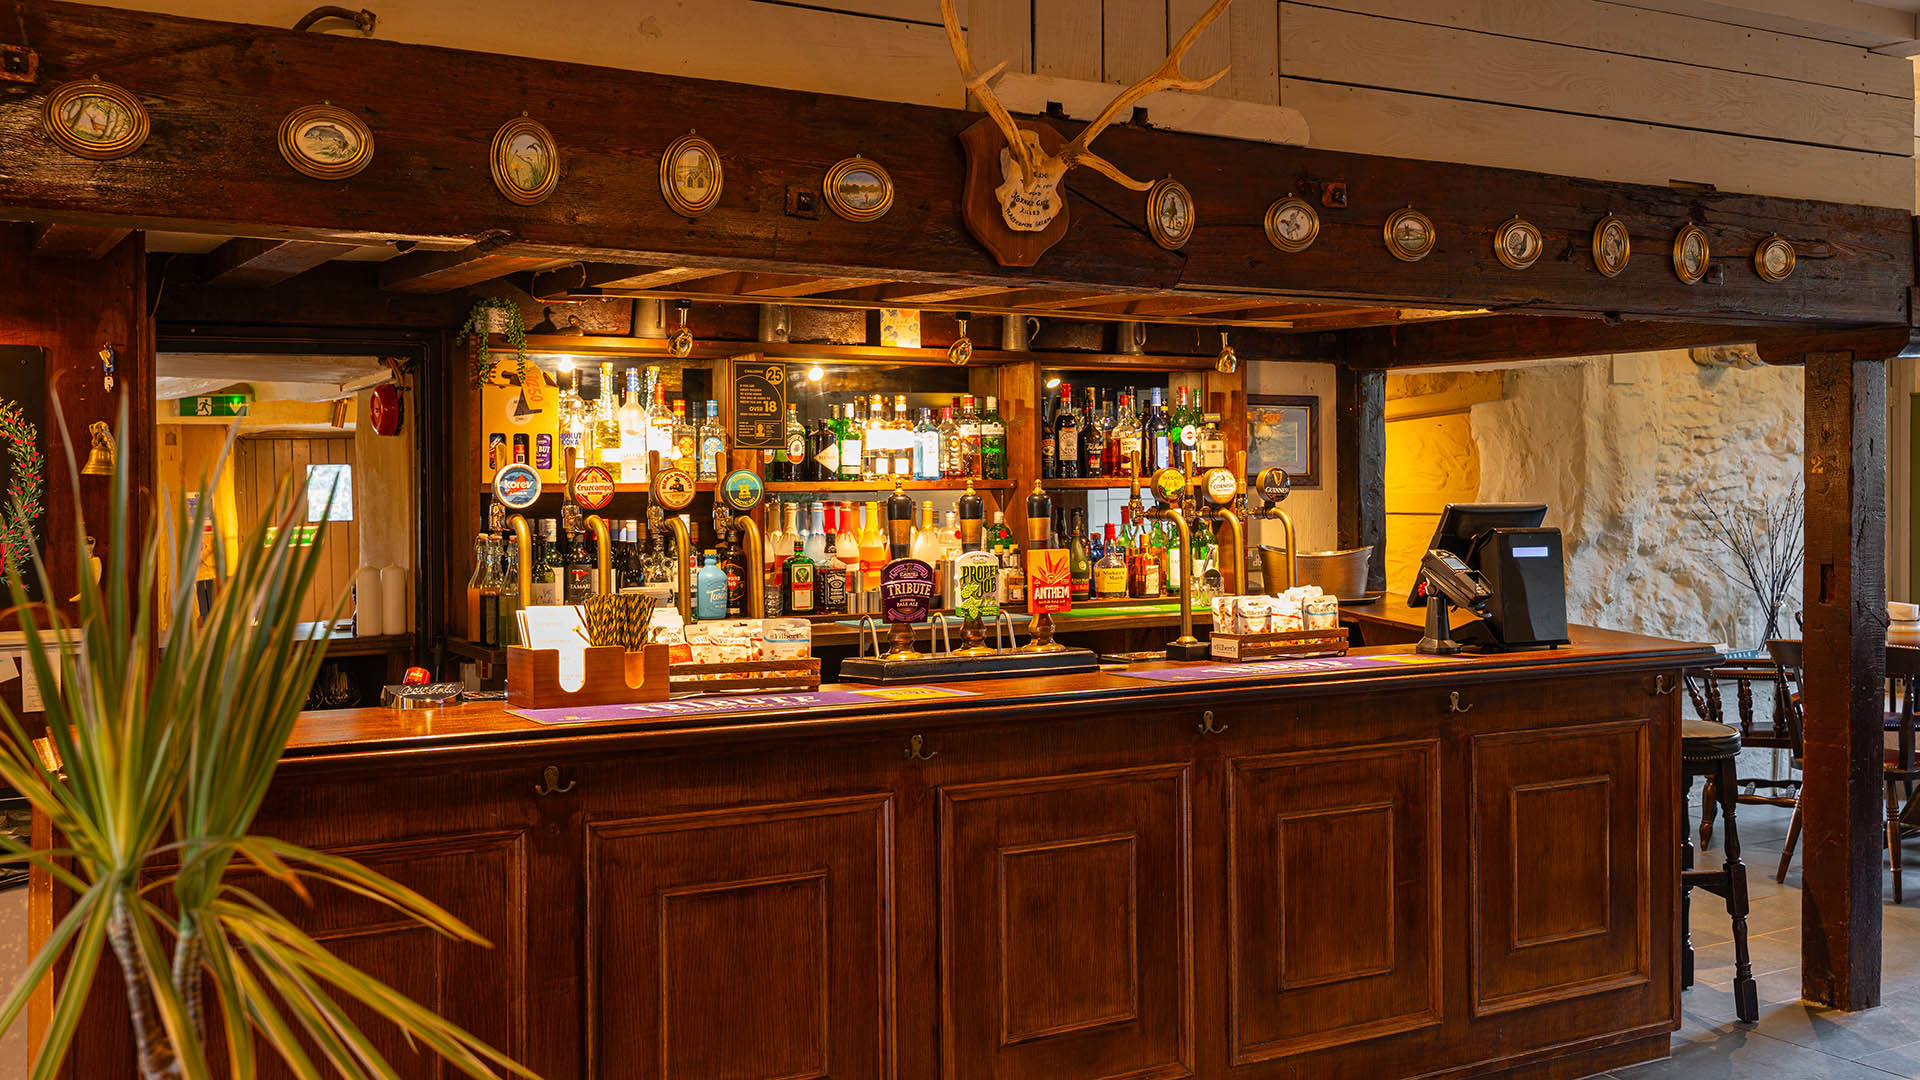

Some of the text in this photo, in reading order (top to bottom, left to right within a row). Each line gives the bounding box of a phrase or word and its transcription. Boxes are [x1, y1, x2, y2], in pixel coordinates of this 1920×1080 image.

[767, 369, 782, 382] 25
[763, 400, 778, 413] 18
[503, 479, 534, 490] korev
[577, 484, 612, 492] Cruzcampo
[1265, 486, 1289, 494] GUINNESS
[886, 582, 932, 596] TRIBUTE
[976, 577, 997, 597] JOB
[1034, 585, 1070, 600] ANTHEM
[621, 695, 821, 713] TRIBUTE
